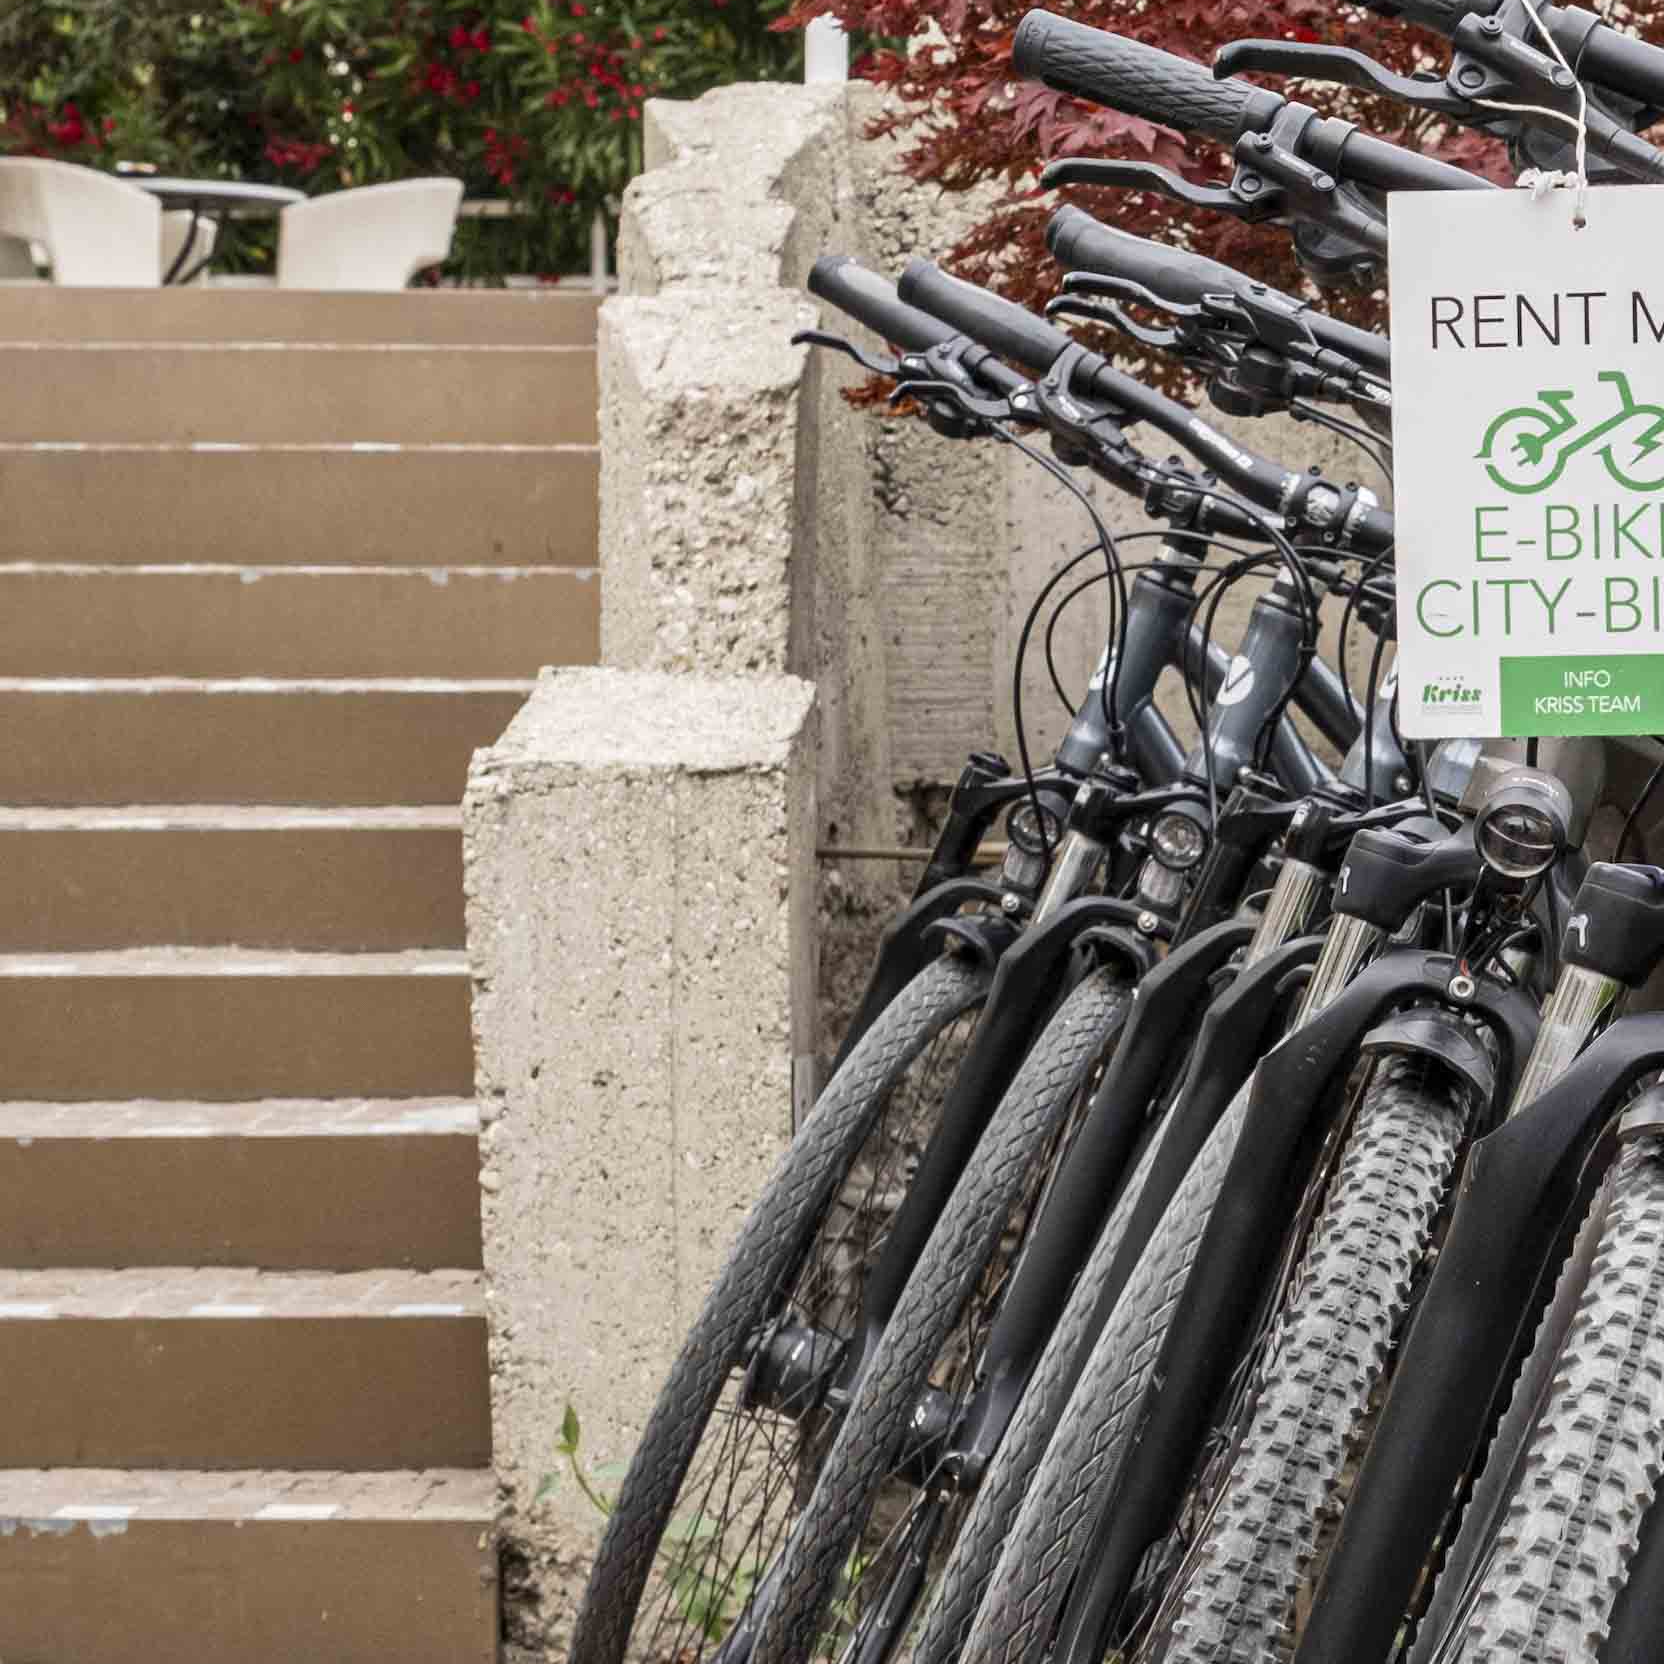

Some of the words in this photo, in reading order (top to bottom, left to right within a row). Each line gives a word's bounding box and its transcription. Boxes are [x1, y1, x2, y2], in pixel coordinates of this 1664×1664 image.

[1430, 291, 1607, 349] RENT
[1564, 670, 1611, 688] INFO
[1422, 683, 1482, 703] Kriss
[1535, 696, 1585, 714] KRISS
[1587, 695, 1641, 713] TEAM
